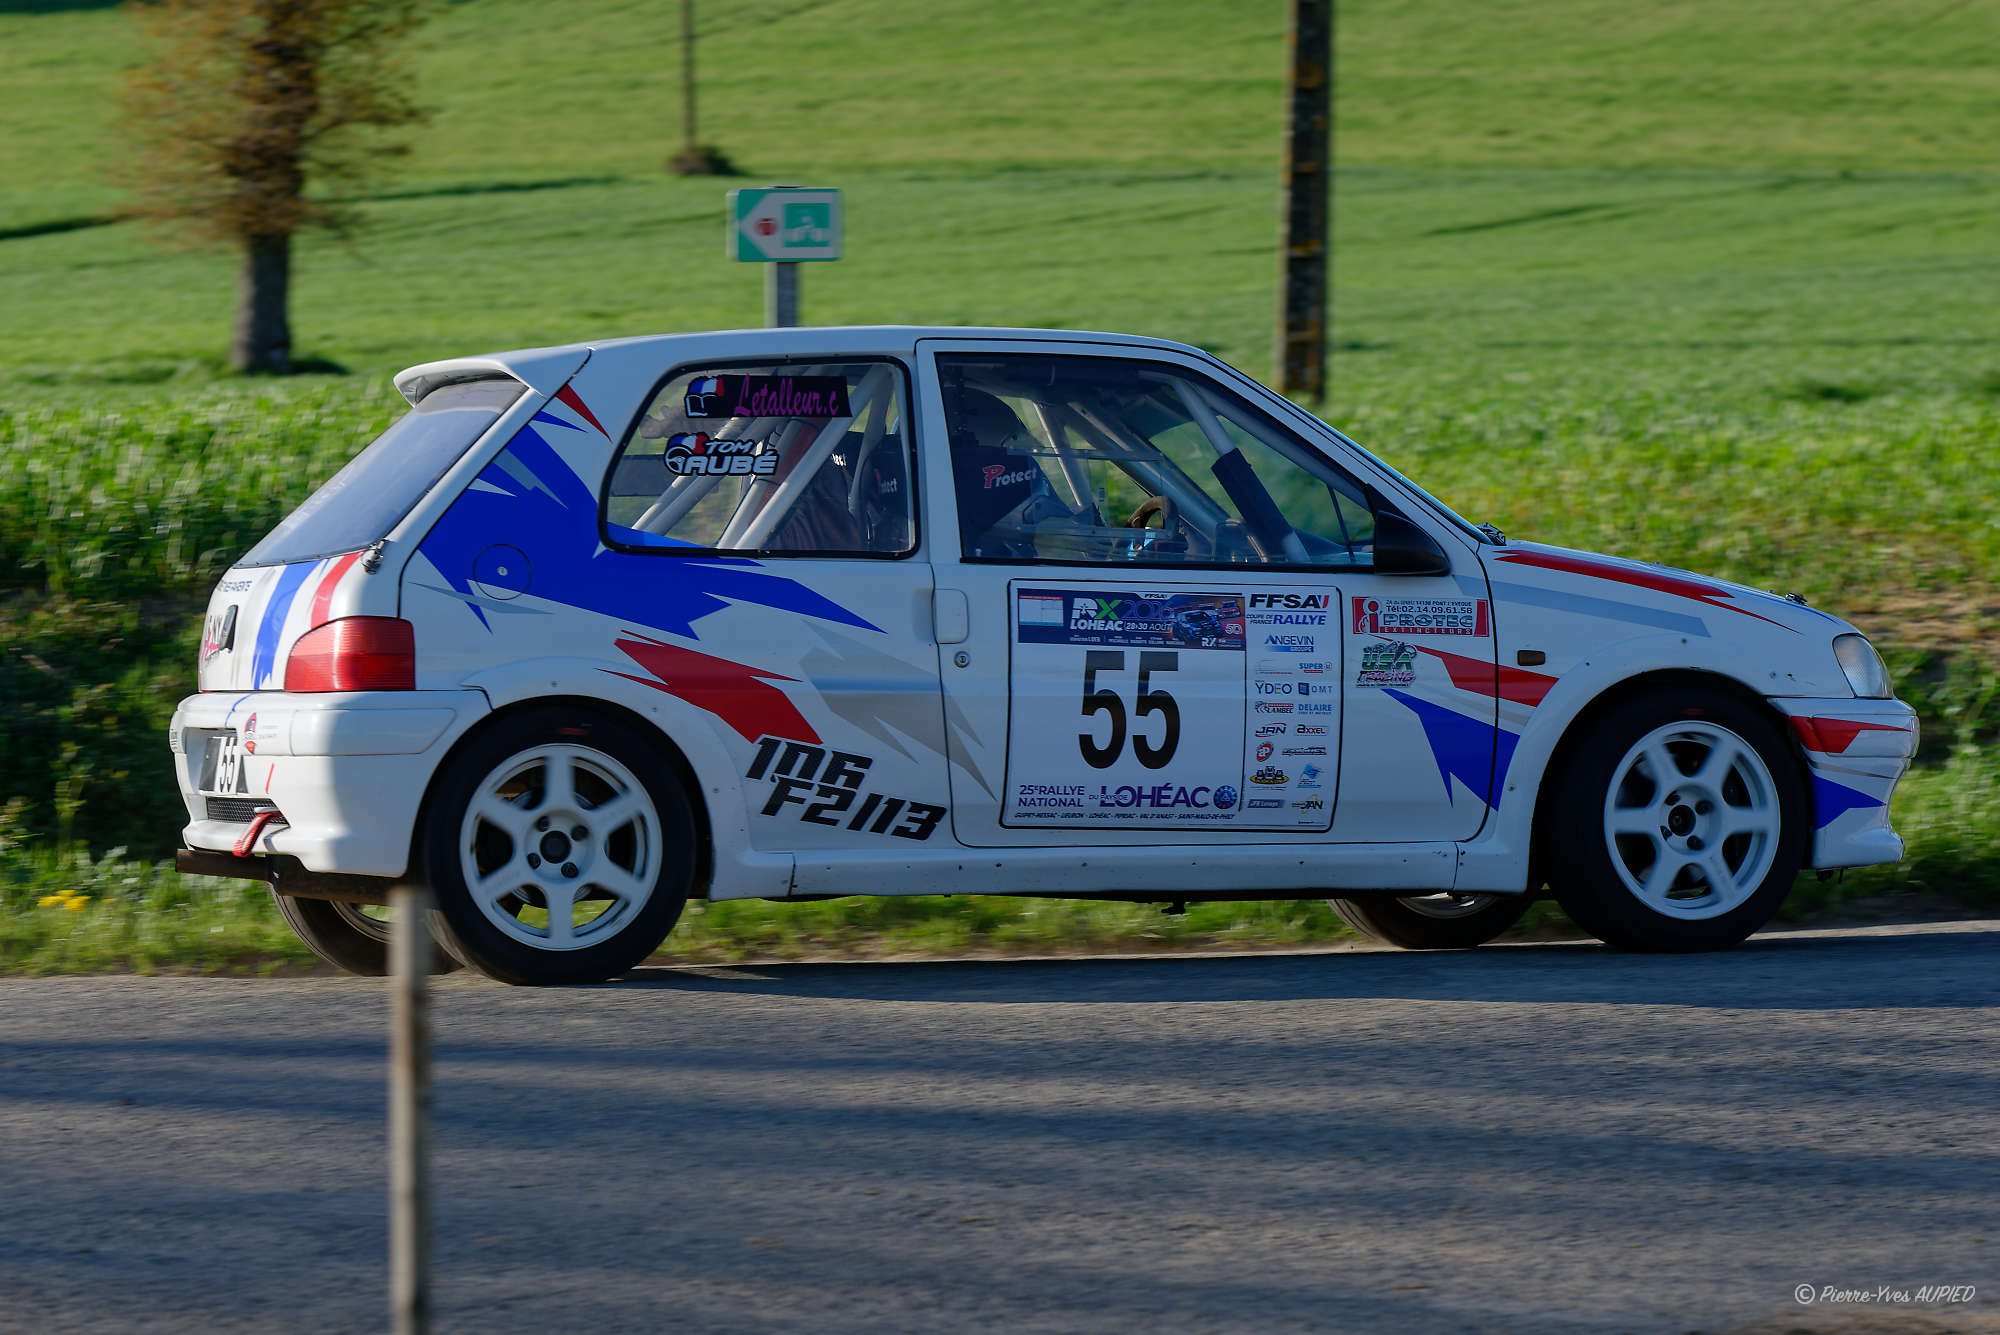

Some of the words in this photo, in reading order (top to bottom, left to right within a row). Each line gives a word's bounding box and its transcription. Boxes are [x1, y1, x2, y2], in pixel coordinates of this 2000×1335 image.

[705, 441, 753, 454] TOM
[684, 450, 778, 474] AUBÉ
[982, 464, 1037, 488] Protect
[1249, 593, 1321, 609] FFSA
[1072, 597, 1123, 621] RX
[1069, 620, 1124, 632] LOHEAC
[1273, 614, 1327, 625] RALLYE
[1383, 613, 1473, 628] PROTEC
[1264, 634, 1314, 645] ANGEVIN
[1361, 653, 1413, 671] USA
[1255, 682, 1293, 695] YDEO
[1079, 650, 1180, 770] 55
[1298, 703, 1332, 712] DELAIRE
[745, 736, 874, 790] 106
[1018, 797, 1084, 807] NATIONAL
[1100, 782, 1210, 808] LOHÉAC
